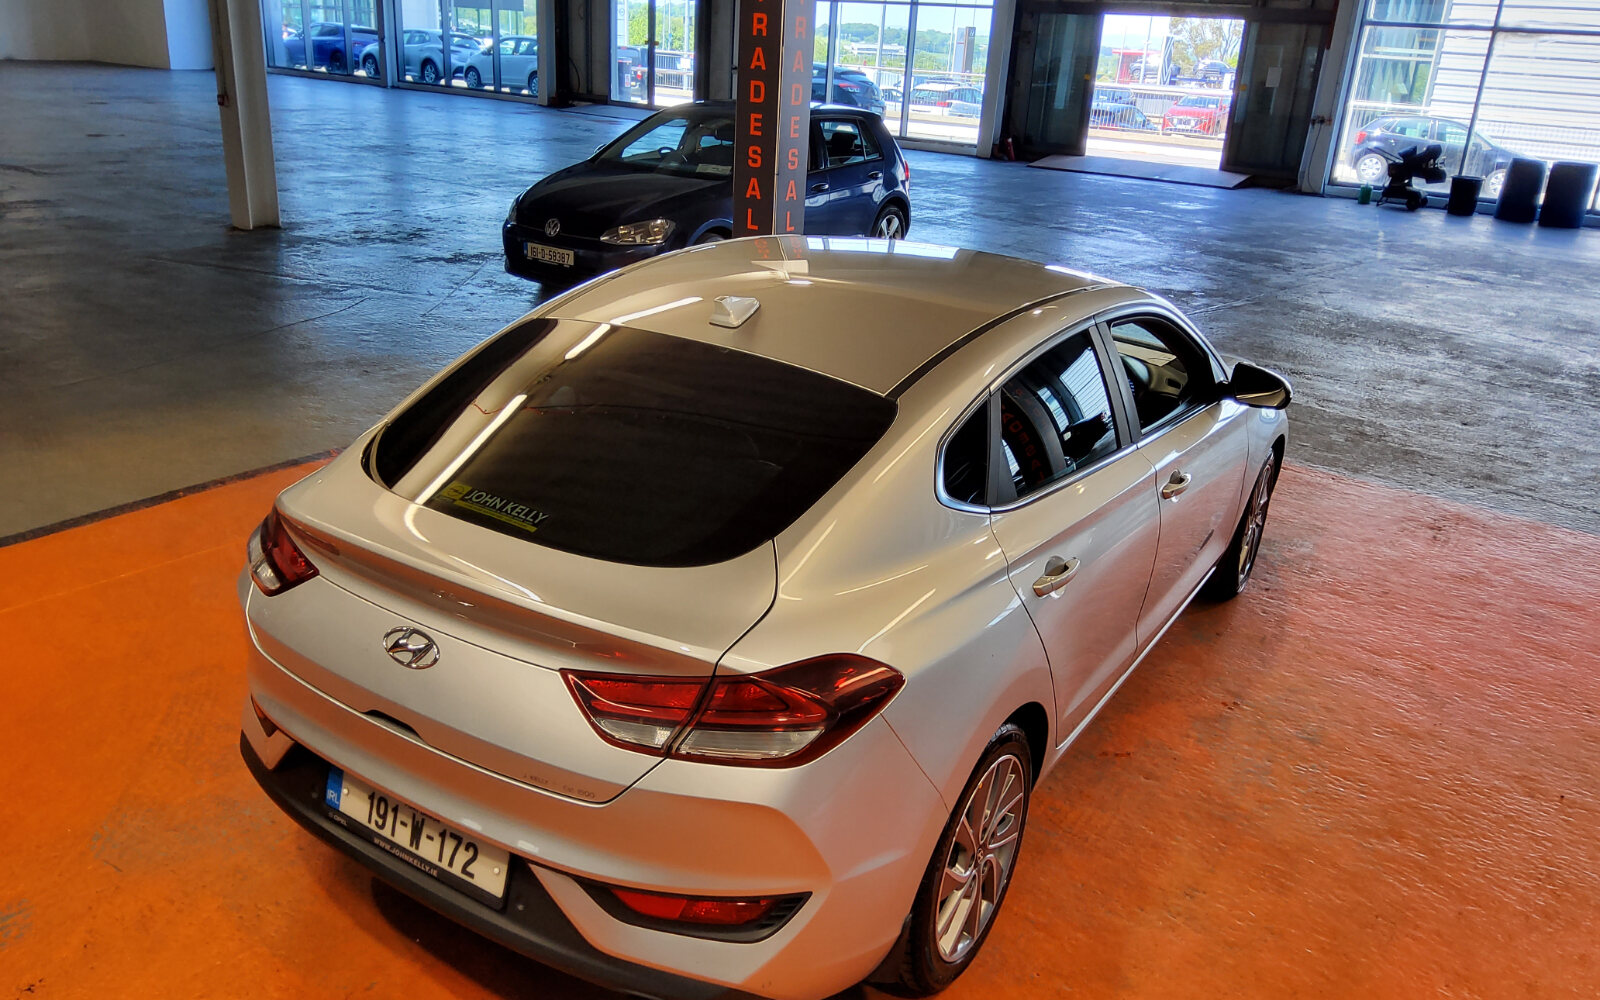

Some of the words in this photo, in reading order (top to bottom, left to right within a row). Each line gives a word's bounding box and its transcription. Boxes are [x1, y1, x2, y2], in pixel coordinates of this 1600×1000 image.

[465, 489, 508, 510] JOHN
[502, 502, 550, 524] KELLY
[326, 788, 340, 804] IRL
[367, 791, 479, 880] 191-W-172
